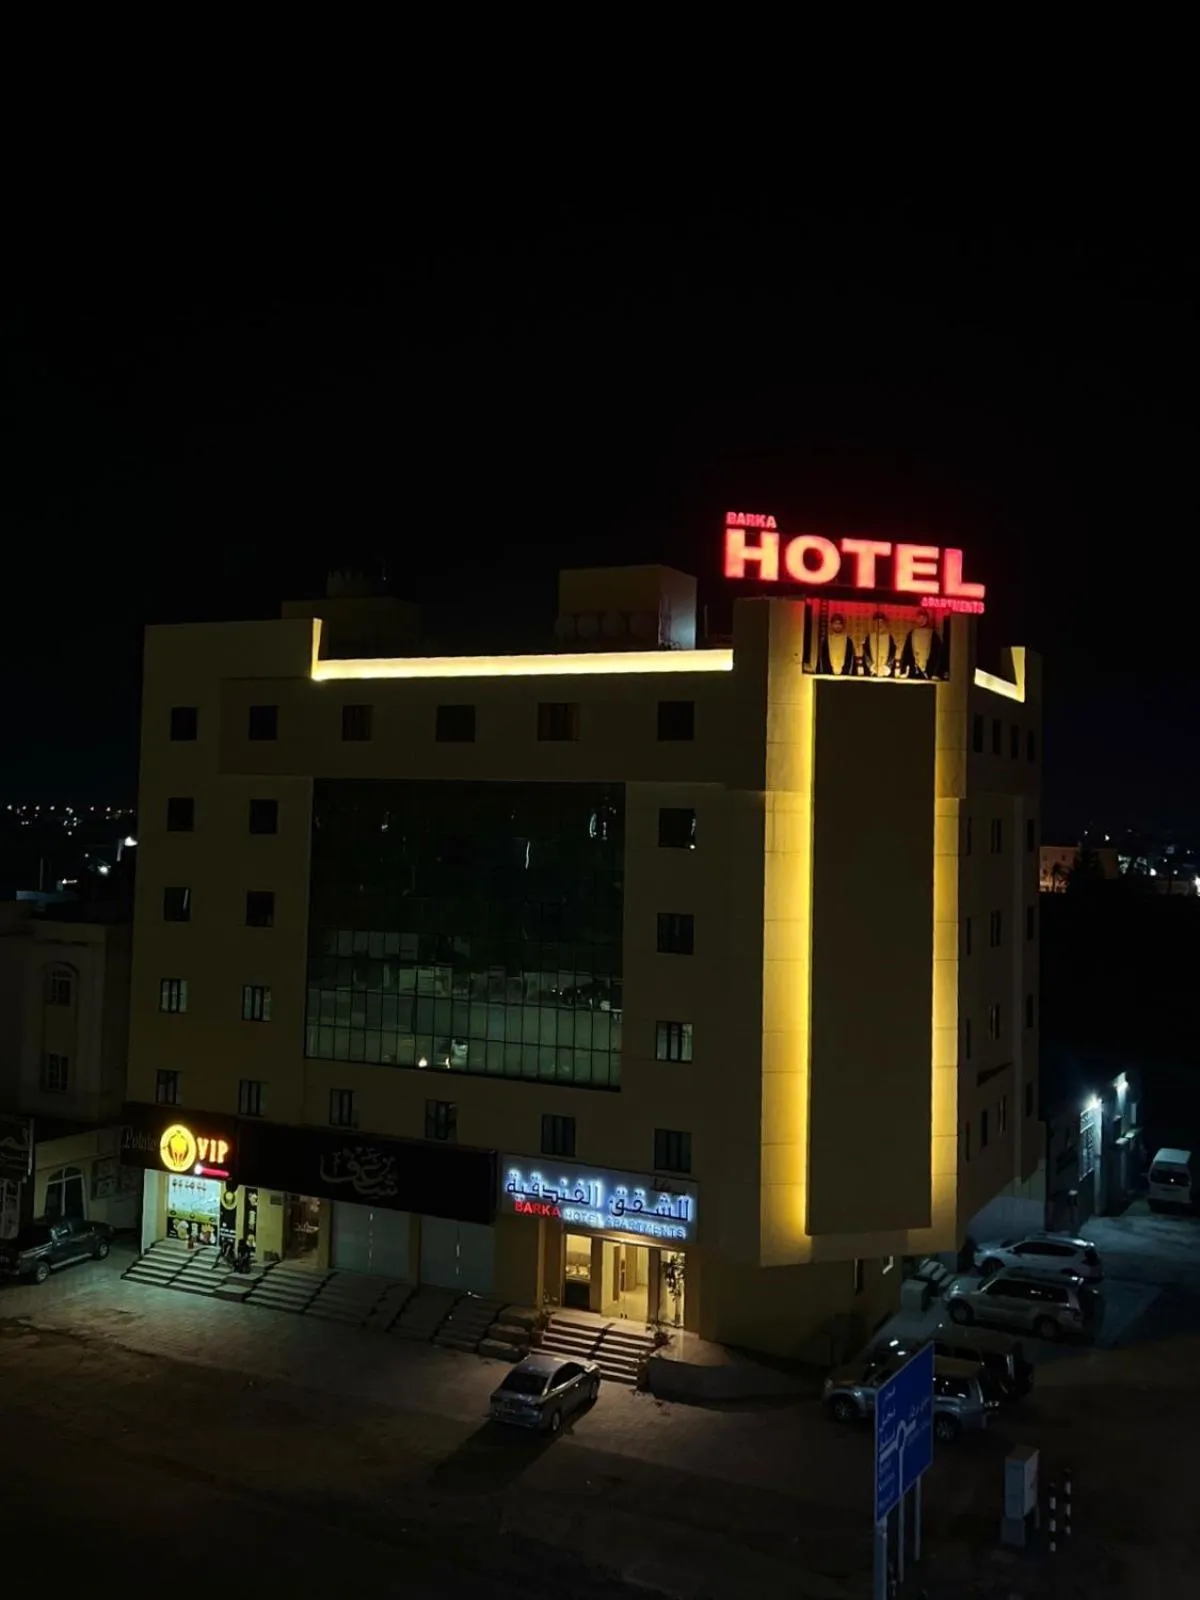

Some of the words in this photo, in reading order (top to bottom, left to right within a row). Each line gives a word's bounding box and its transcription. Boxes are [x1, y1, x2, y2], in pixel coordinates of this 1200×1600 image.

[726, 511, 777, 529] BARKA
[724, 528, 986, 599] HOTEL
[196, 1137, 229, 1164] VIP
[505, 1169, 603, 1208] الفندقية
[609, 1186, 693, 1222] الشقق
[514, 1200, 561, 1218] BARKA
[563, 1208, 604, 1228] HOTEL
[606, 1217, 686, 1239] APARTMENTS
